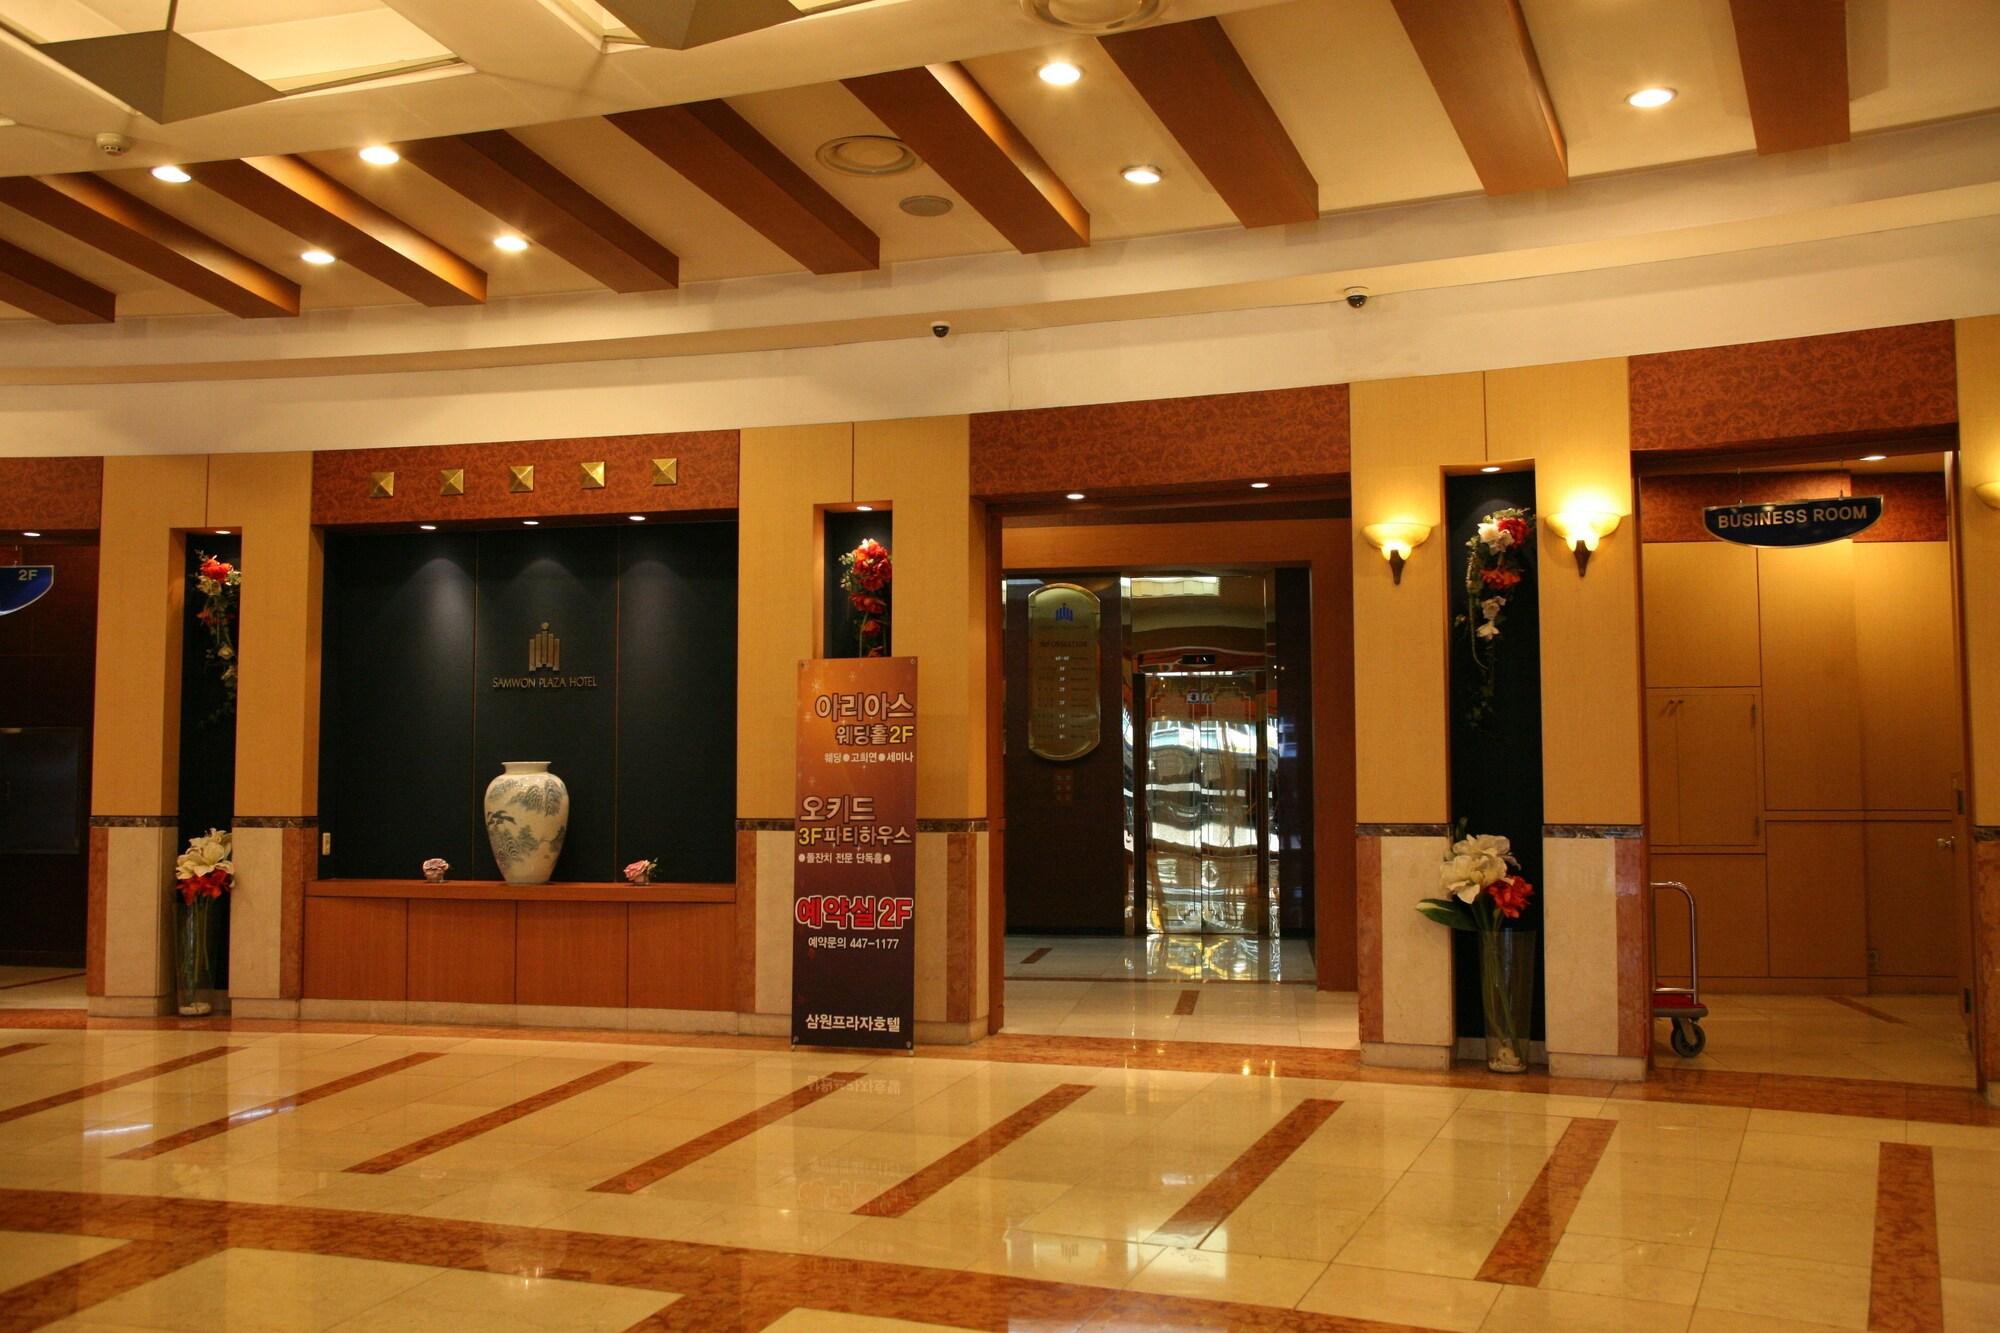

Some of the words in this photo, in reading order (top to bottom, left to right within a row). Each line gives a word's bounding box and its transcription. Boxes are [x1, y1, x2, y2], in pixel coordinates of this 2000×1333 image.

[1718, 511, 1808, 529] BUSINESS
[1813, 505, 1868, 522] ROOM
[18, 569, 39, 581] 2F
[492, 677, 535, 688] SAMWON
[538, 677, 566, 688] PLAZA
[569, 676, 597, 687] HOTEL
[815, 692, 915, 721] 아리아스
[800, 795, 876, 823] 오키드
[808, 936, 847, 949] 예약문의
[849, 938, 899, 949] 447-1177
[805, 1013, 900, 1033] 삼원프라자호텔
